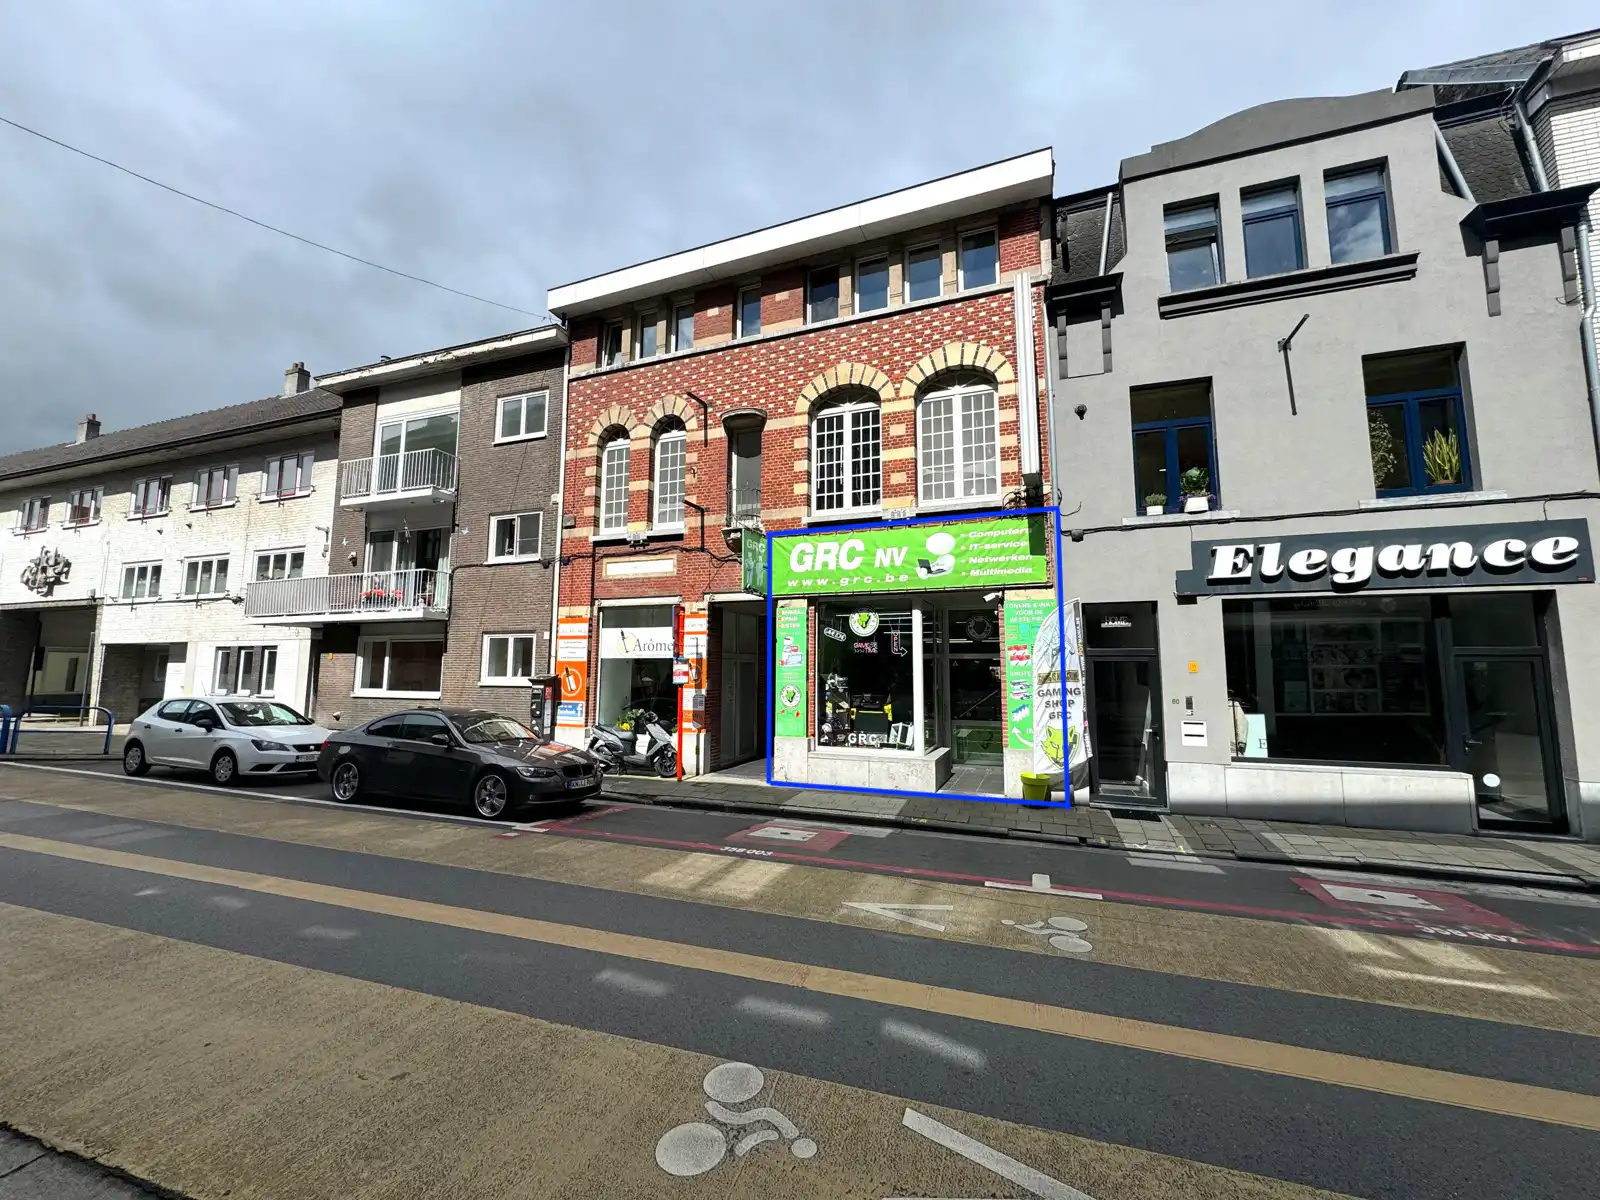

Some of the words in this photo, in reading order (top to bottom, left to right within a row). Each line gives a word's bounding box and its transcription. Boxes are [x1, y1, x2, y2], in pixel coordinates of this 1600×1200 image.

[746, 538, 766, 553] GRC
[968, 540, 1028, 551] IT-service
[789, 538, 865, 573] GRC
[873, 546, 909, 569] NV
[968, 553, 1033, 564] Netwerken
[1206, 535, 1580, 587] Elegance
[969, 566, 1033, 577] Multimedia
[787, 572, 910, 588] www.grc.be
[1037, 687, 1082, 698] GAMNG
